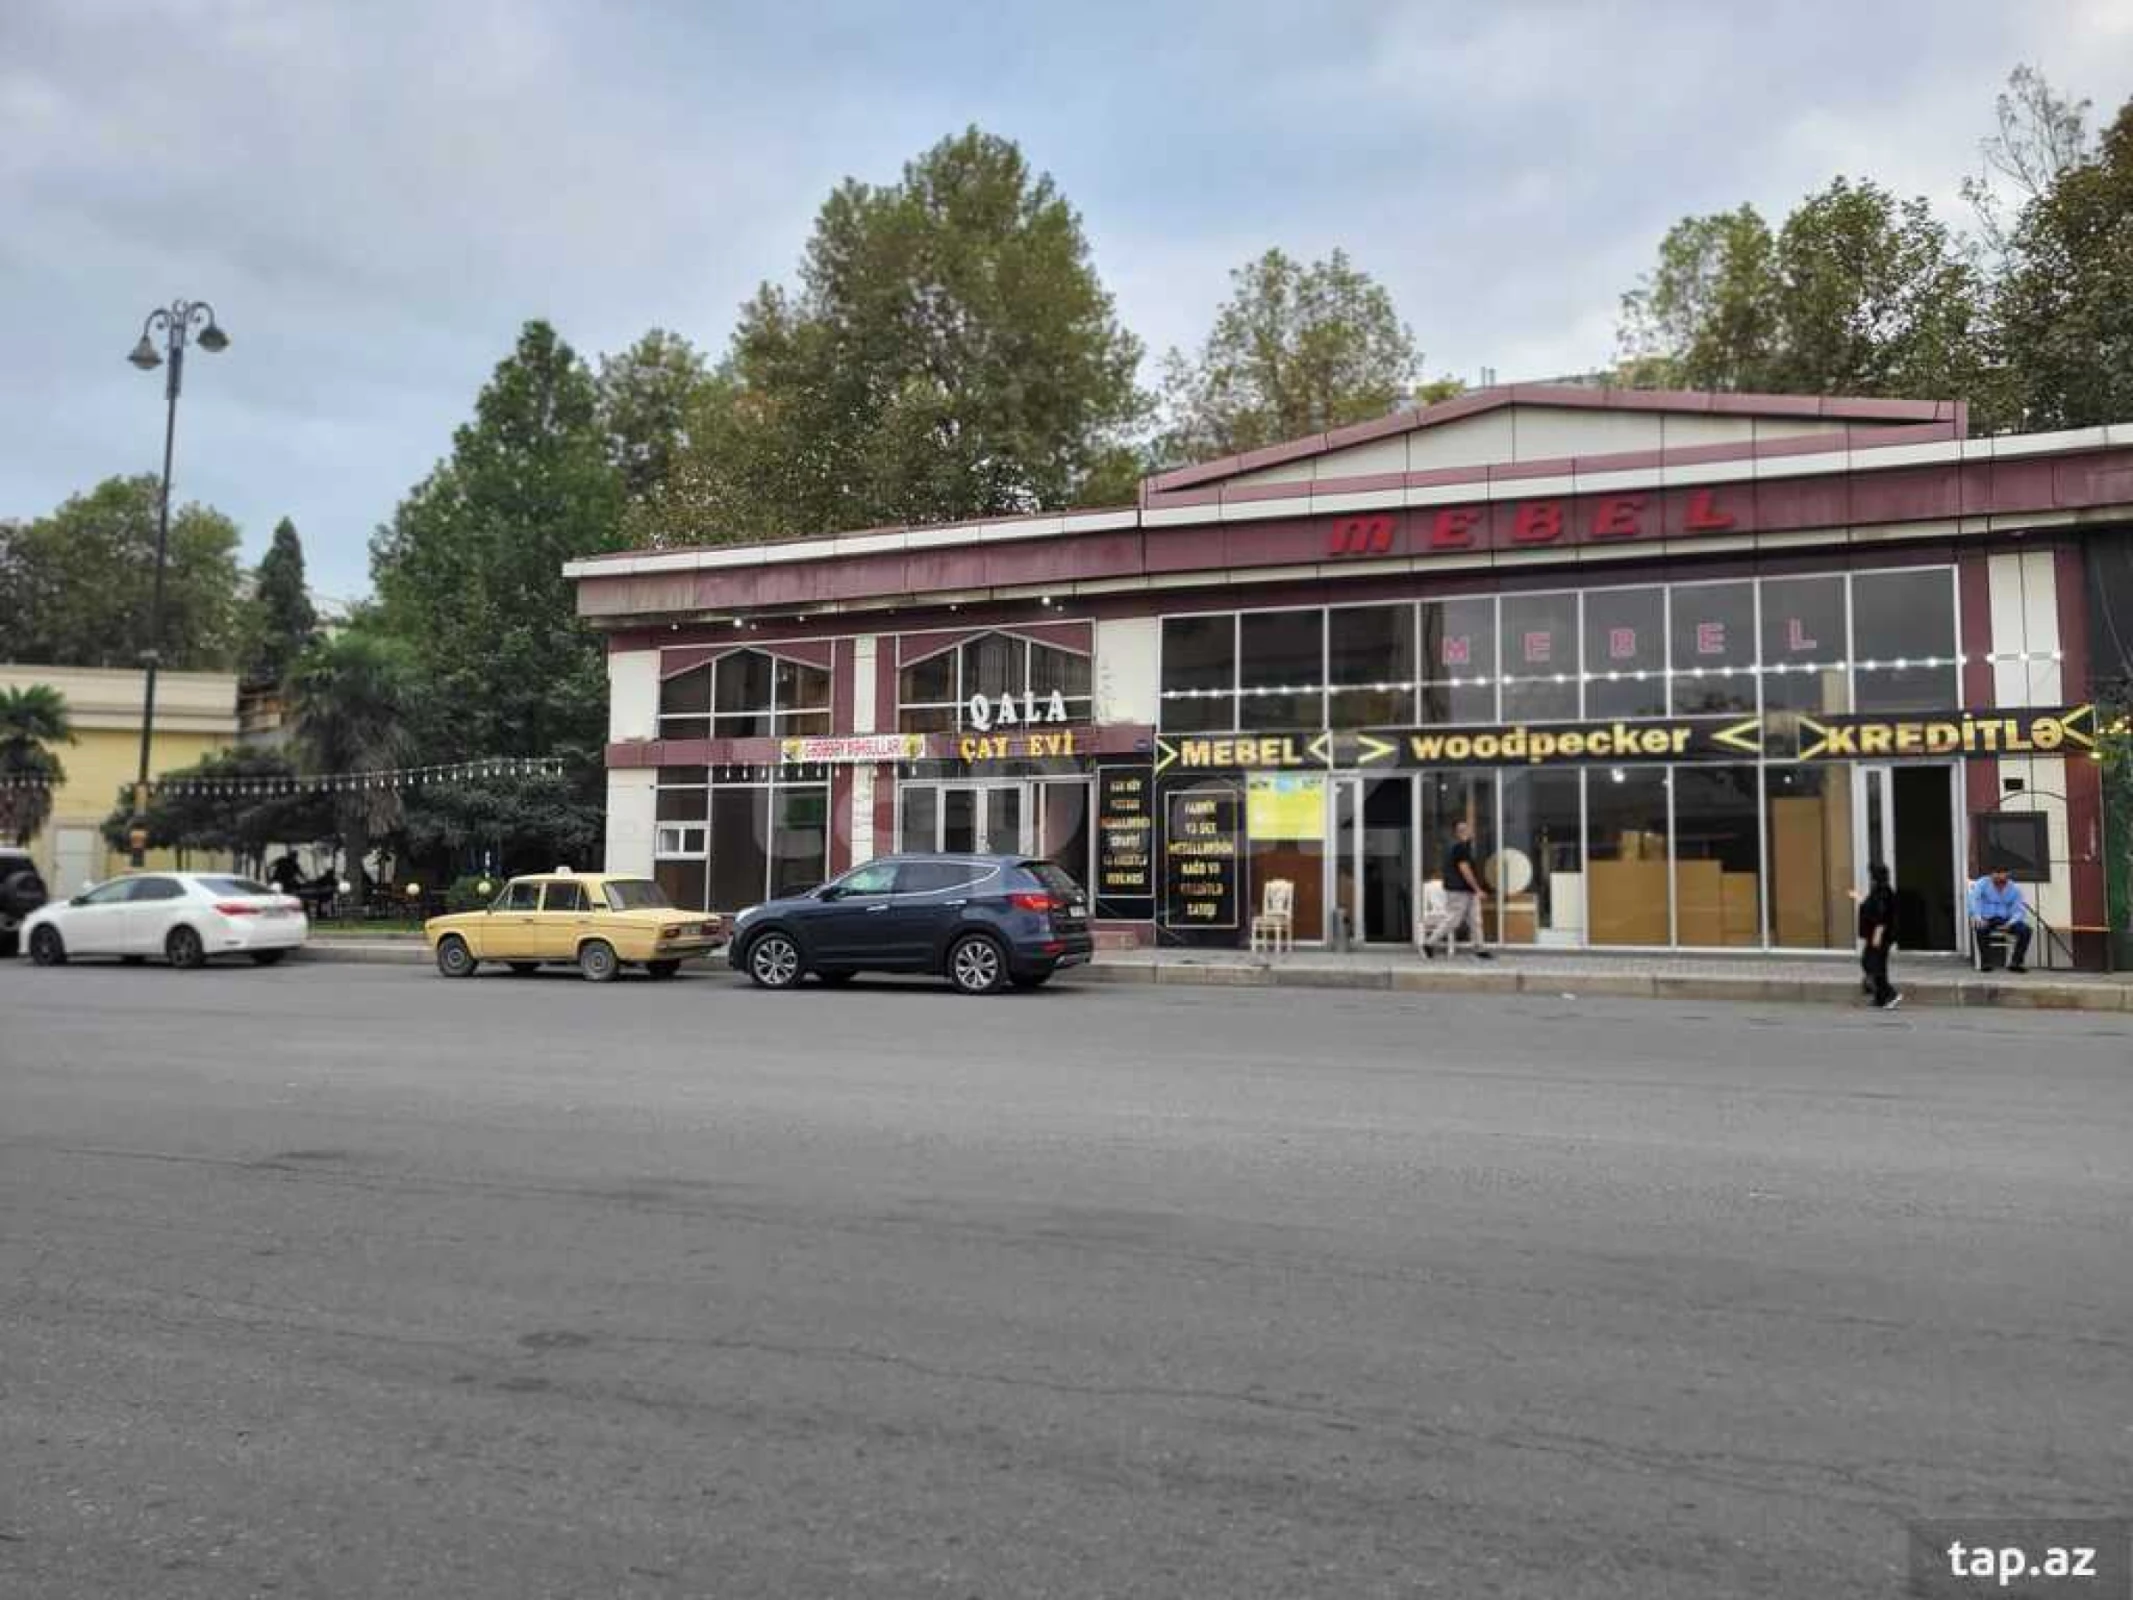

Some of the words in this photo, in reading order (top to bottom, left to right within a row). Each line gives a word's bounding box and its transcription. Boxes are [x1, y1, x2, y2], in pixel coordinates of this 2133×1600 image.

[1328, 491, 1736, 556] MEBEL
[1442, 618, 1817, 665] MEBEL
[970, 689, 1068, 731] QALA
[1180, 738, 1303, 767] MEBEL
[1410, 721, 1692, 764] woodpecker
[1826, 711, 2064, 754] KREDİTLƏ
